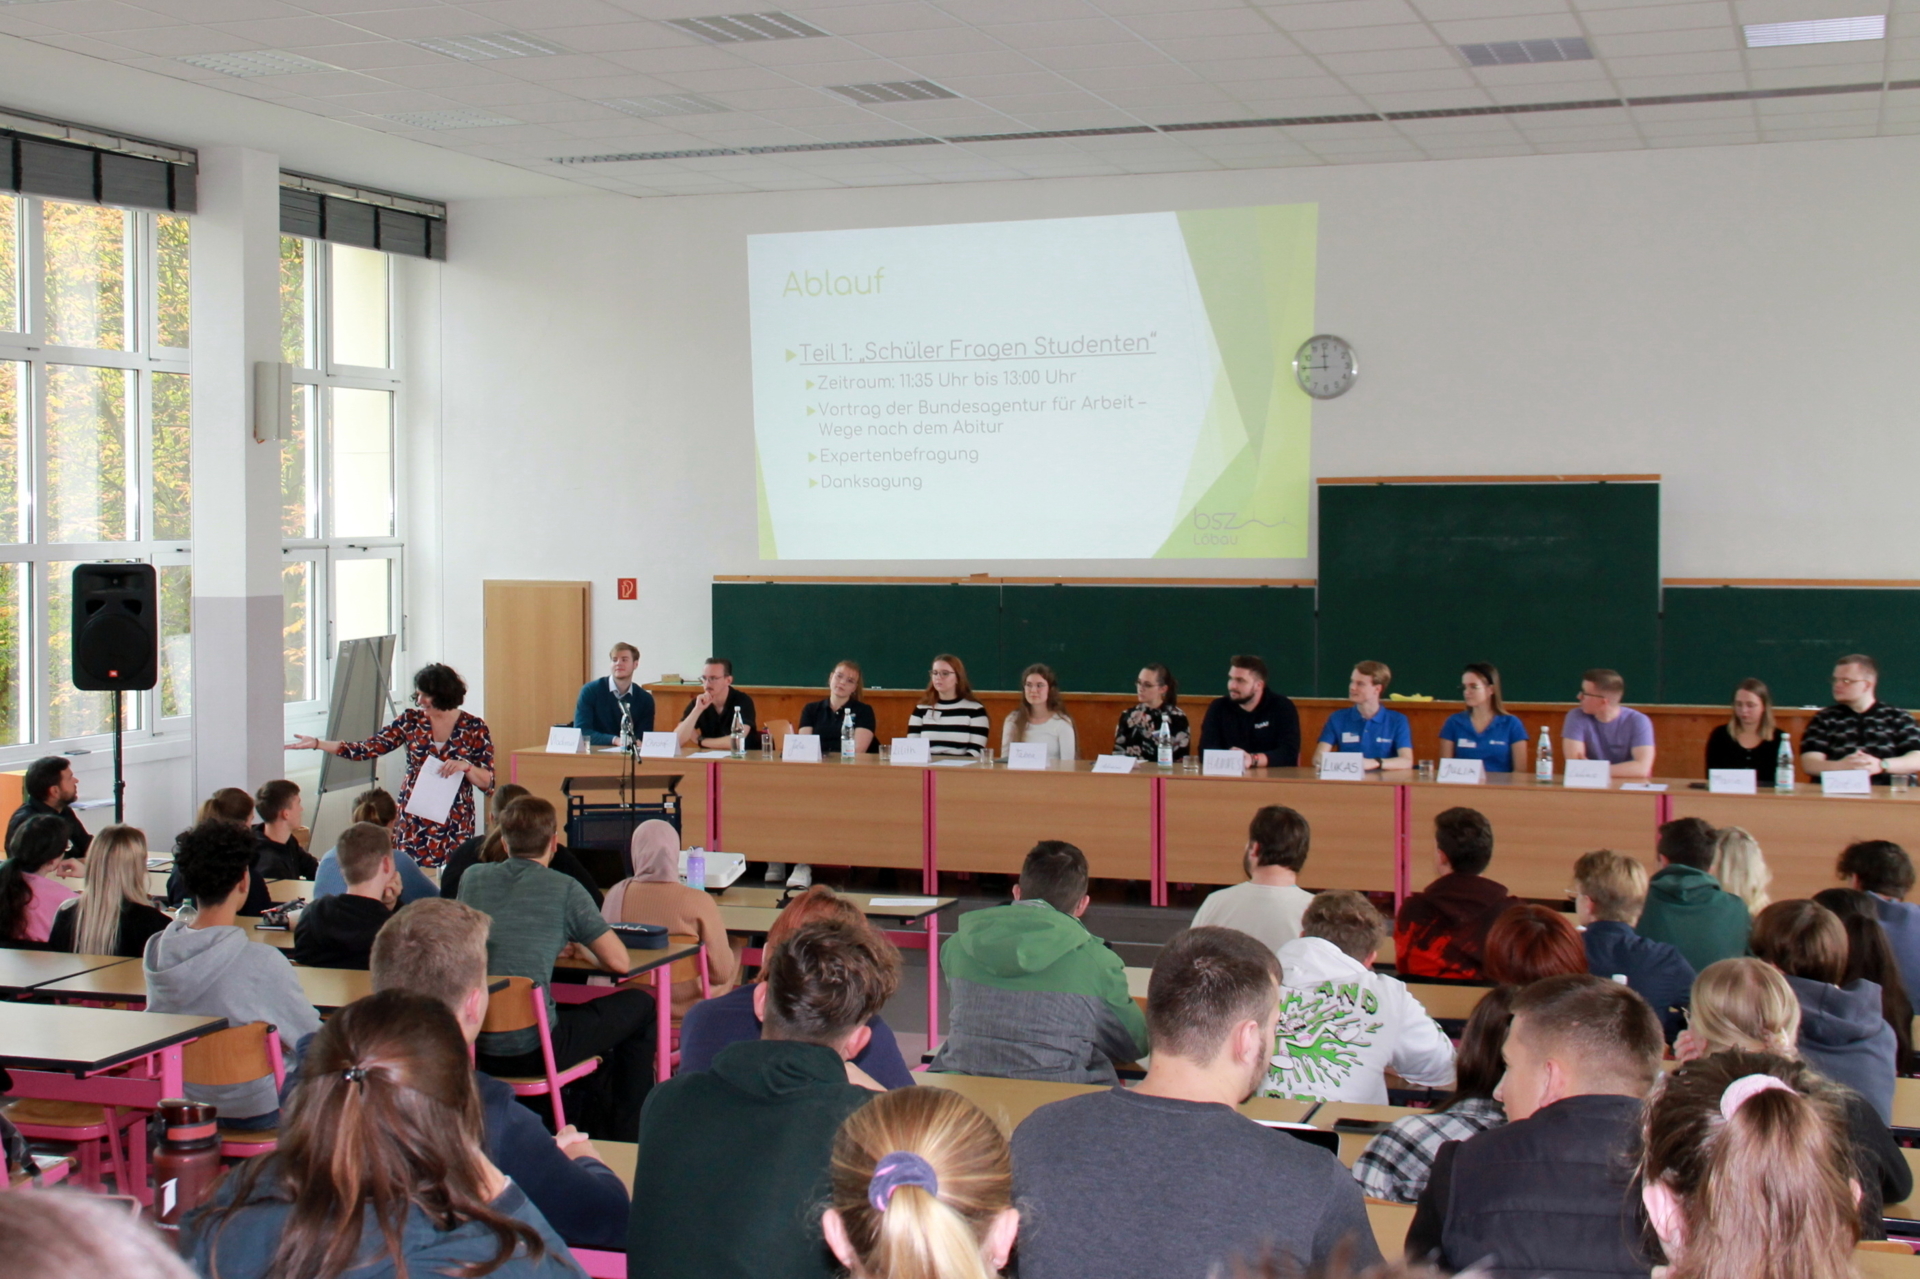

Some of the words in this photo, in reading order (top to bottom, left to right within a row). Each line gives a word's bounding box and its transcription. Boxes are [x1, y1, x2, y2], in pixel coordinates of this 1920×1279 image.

[782, 266, 885, 298] Ablauf
[799, 342, 837, 362] Teil
[841, 342, 853, 362] 1:
[949, 338, 1027, 362] Fragen
[817, 374, 896, 391] Zeitraum:
[899, 372, 934, 389] 11:35
[938, 372, 969, 388] Uhr
[973, 371, 999, 386] bis
[1002, 370, 1041, 386] 13:00
[1045, 369, 1077, 384] Uhr
[818, 402, 882, 419] Vortrag
[886, 400, 914, 416] der
[918, 398, 1047, 417] Bundesagentur
[1052, 396, 1077, 411] für
[1081, 395, 1134, 410] Arbeit
[818, 422, 863, 440] Wege
[867, 421, 908, 436] nach
[912, 420, 948, 435] dem
[952, 419, 1005, 434] Abitur
[820, 447, 979, 466] Expertenbefragung
[821, 473, 923, 491] Danksagung
[1193, 533, 1239, 546] Löbau
[1322, 758, 1359, 773] LUKAS
[1440, 763, 1476, 778] JULIA
[1314, 980, 1379, 1015] AND
